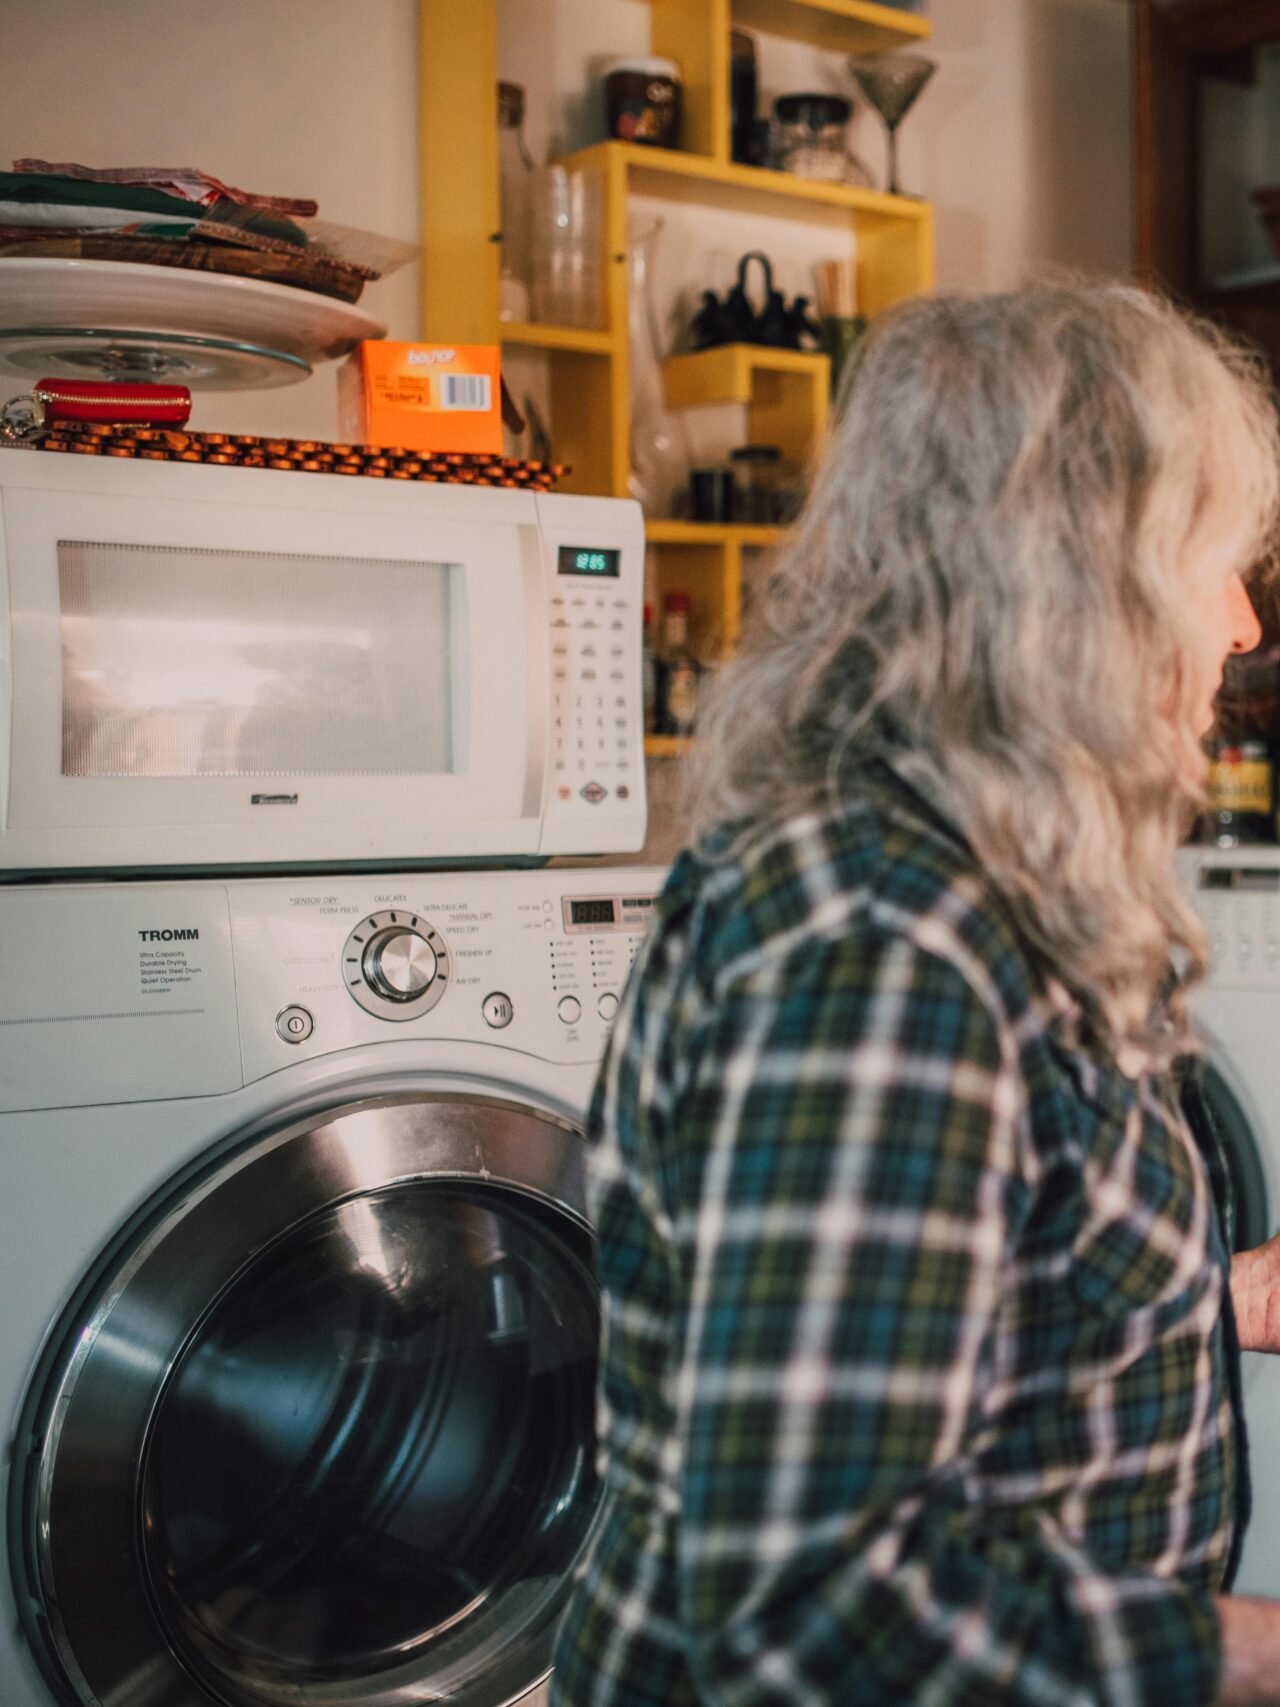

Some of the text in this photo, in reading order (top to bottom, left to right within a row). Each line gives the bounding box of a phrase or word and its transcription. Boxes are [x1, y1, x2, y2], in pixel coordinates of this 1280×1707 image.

[323, 896, 337, 904] DRY
[441, 903, 468, 911] DELICATE
[446, 926, 465, 934] SPEED
[138, 928, 199, 942] TROMM
[155, 951, 185, 959] Capacity
[166, 959, 187, 967] Drying
[160, 976, 192, 984] Operation
